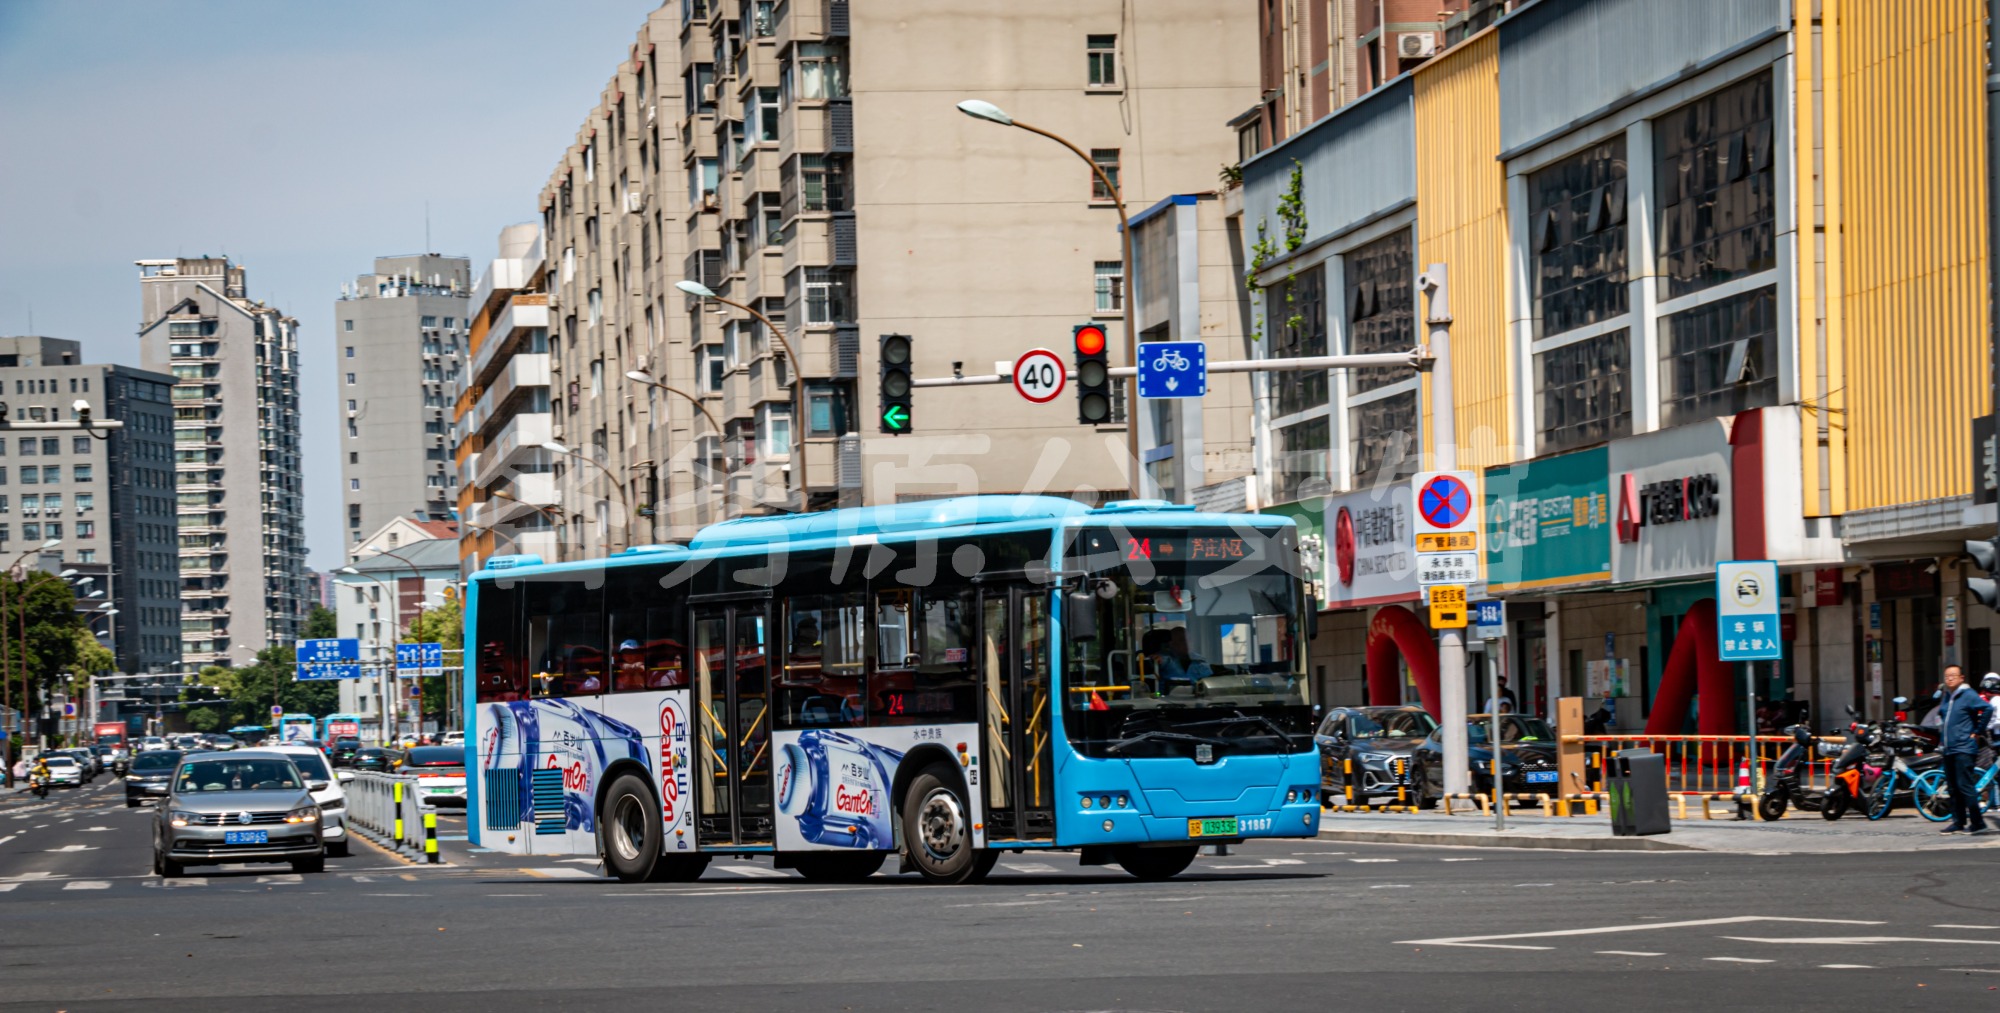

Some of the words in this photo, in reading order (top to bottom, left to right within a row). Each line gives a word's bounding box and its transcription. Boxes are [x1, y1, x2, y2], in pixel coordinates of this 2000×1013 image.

[1023, 363, 1055, 389] 40
[1126, 537, 1152, 560] 24
[1191, 538, 1244, 559] 芦庄小区
[1422, 535, 1471, 548] 严管路段
[1431, 557, 1464, 568] 永乐路
[1432, 589, 1465, 602] 监控区域
[1734, 621, 1765, 633] 车辆
[1724, 638, 1777, 651] 禁止驶入
[888, 694, 905, 715] 24
[913, 727, 943, 740] 水中贵族
[661, 706, 678, 822] Ganten
[850, 763, 870, 780] 百岁山
[836, 784, 873, 815] Ganten
[1204, 820, 1237, 834] 03933F
[1240, 818, 1272, 832] 31867
